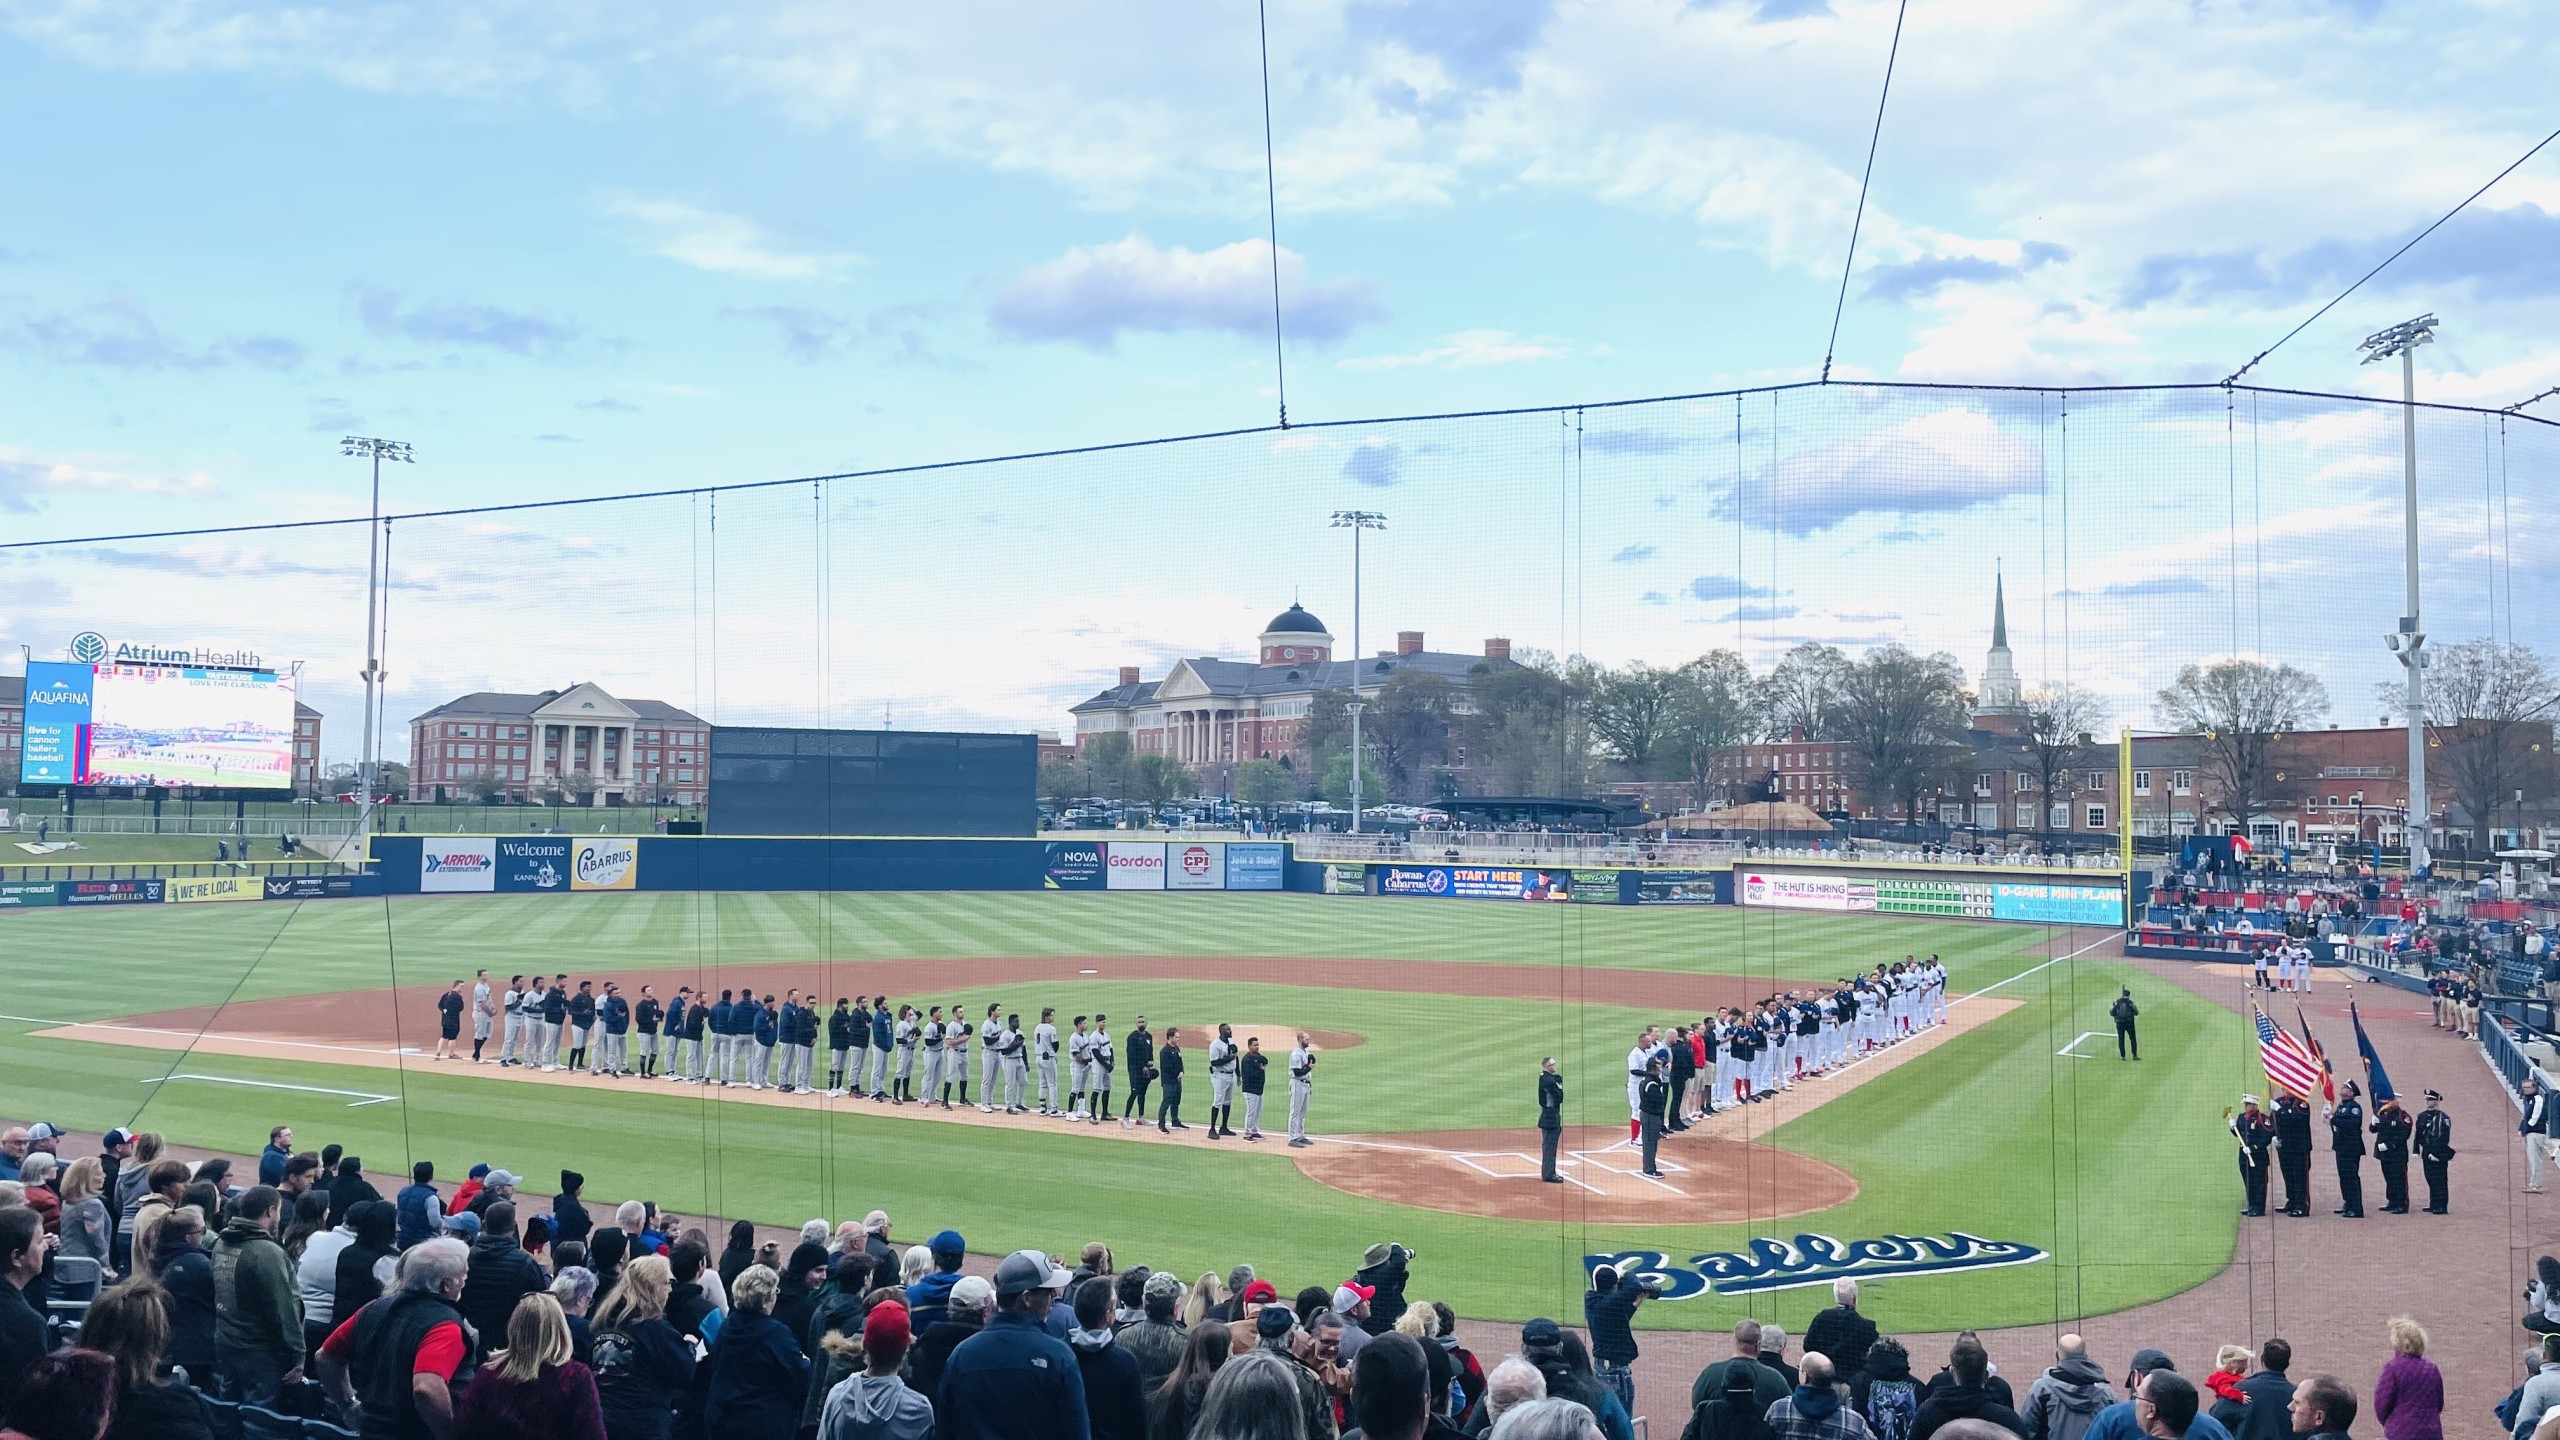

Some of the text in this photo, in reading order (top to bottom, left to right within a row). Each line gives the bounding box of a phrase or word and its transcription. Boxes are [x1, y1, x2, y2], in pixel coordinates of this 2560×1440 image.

[115, 643, 260, 666] Atrium Health
[231, 681, 268, 689] CLASSICS
[29, 690, 90, 706] AQUAFINA
[28, 726, 62, 735] live for
[27, 745, 58, 753] ballers
[27, 754, 64, 762] baseball
[502, 843, 565, 857] Welcome
[441, 854, 483, 866] ARROW
[529, 859, 538, 868] to
[1064, 852, 1099, 863] NOVA
[1108, 855, 1163, 867] Gordon
[1183, 856, 1209, 866] CPI
[1230, 855, 1280, 866] Join a Study!
[577, 847, 632, 881] CABARRUS
[1390, 868, 1426, 880] Rowan-
[1453, 870, 1523, 883] START HERE
[1384, 877, 1427, 889] Cabarrus
[1747, 884, 1765, 893] Pizza
[1772, 881, 1788, 891] THE
[1789, 882, 1806, 892] HUT
[1807, 883, 1815, 893] IS
[1816, 884, 1846, 894] HIRING
[2, 884, 55, 896] year-round
[180, 881, 239, 899] WE'RE LOCAL
[1997, 886, 2048, 899] 10-GAME
[2051, 887, 2078, 900] MINI
[2023, 900, 2039, 909] CALL
[1583, 1232, 2050, 1300] Ballers
